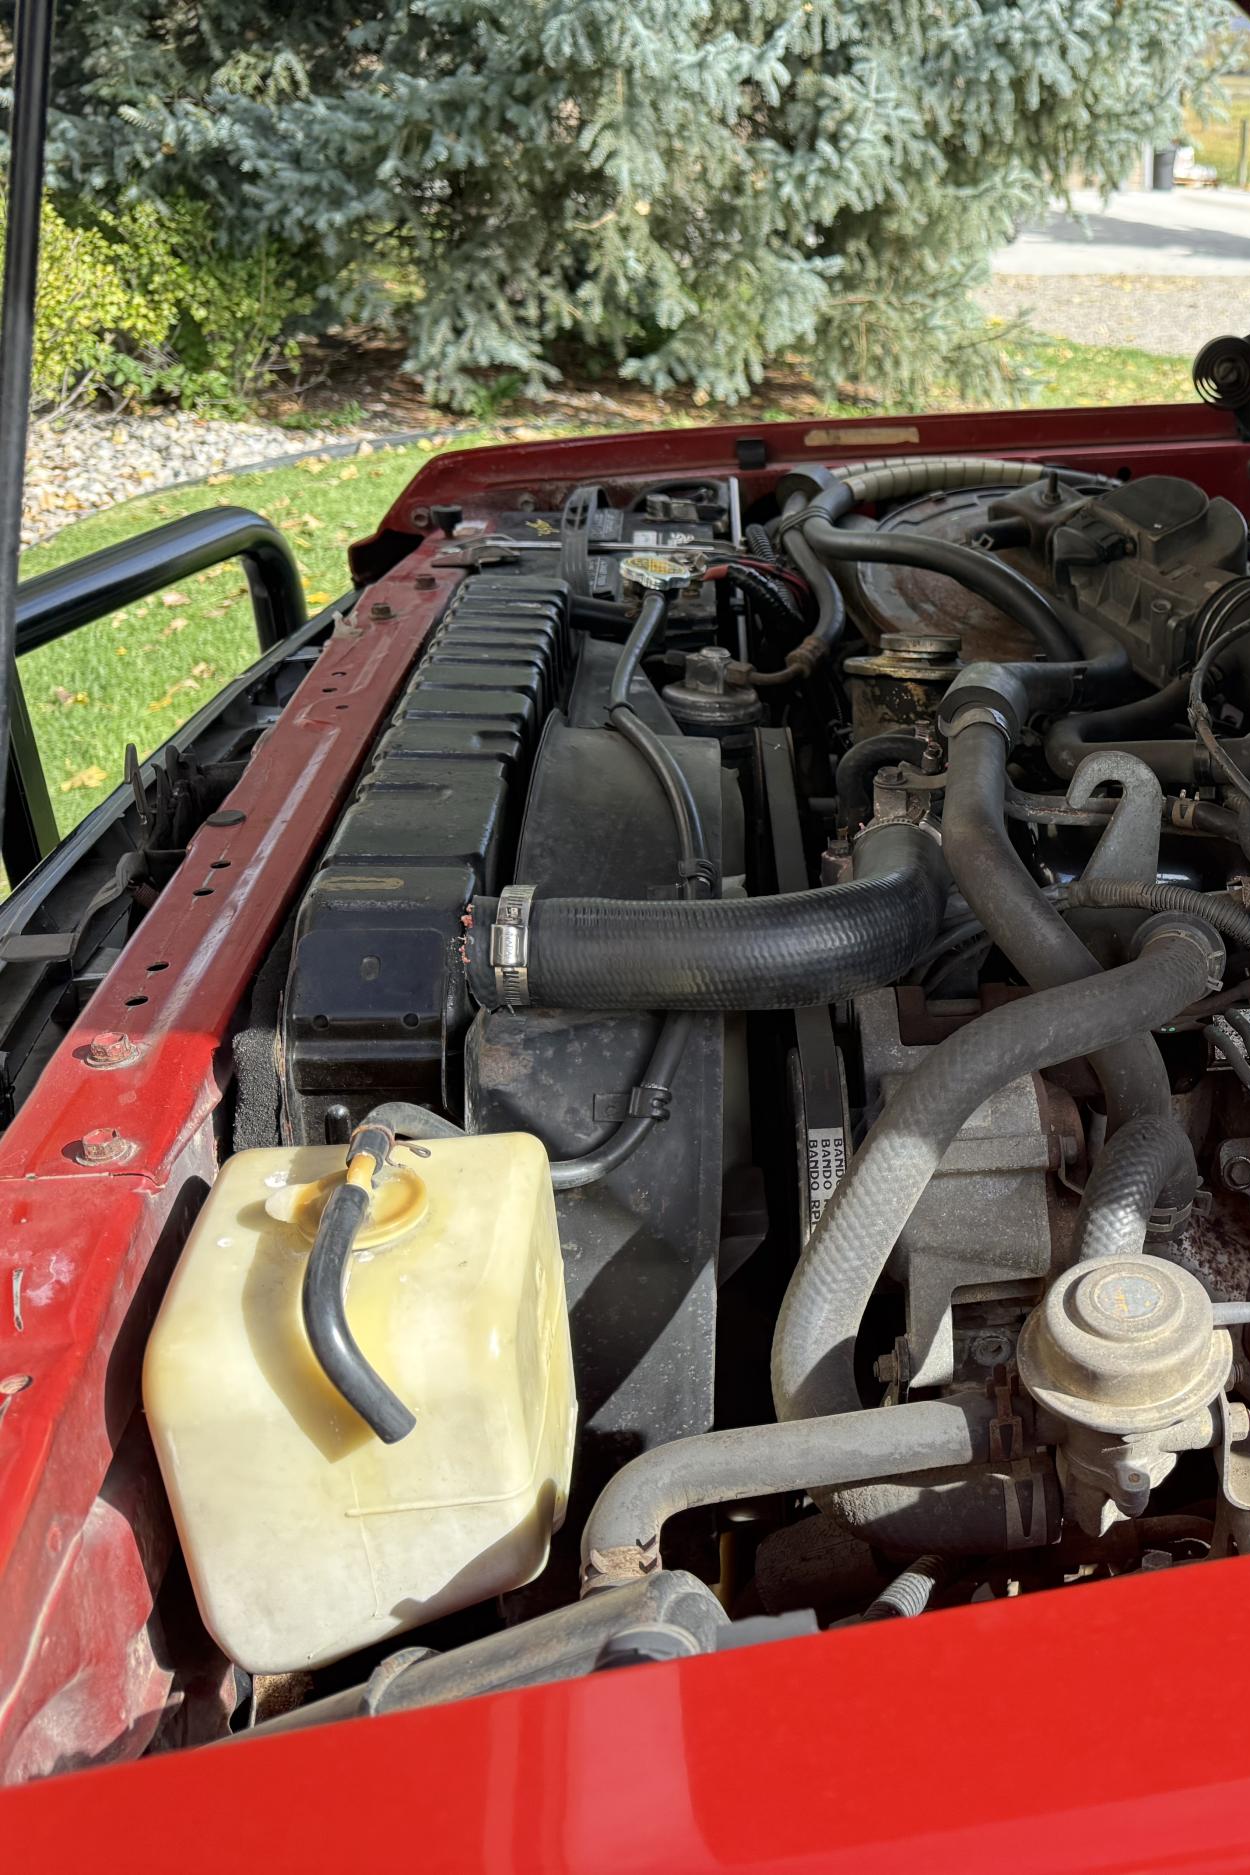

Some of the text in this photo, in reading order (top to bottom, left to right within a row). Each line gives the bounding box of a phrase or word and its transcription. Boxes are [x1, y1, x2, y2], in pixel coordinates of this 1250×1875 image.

[809, 1140, 821, 1224] BANDO RP
[821, 1139, 832, 1190] BANDO
